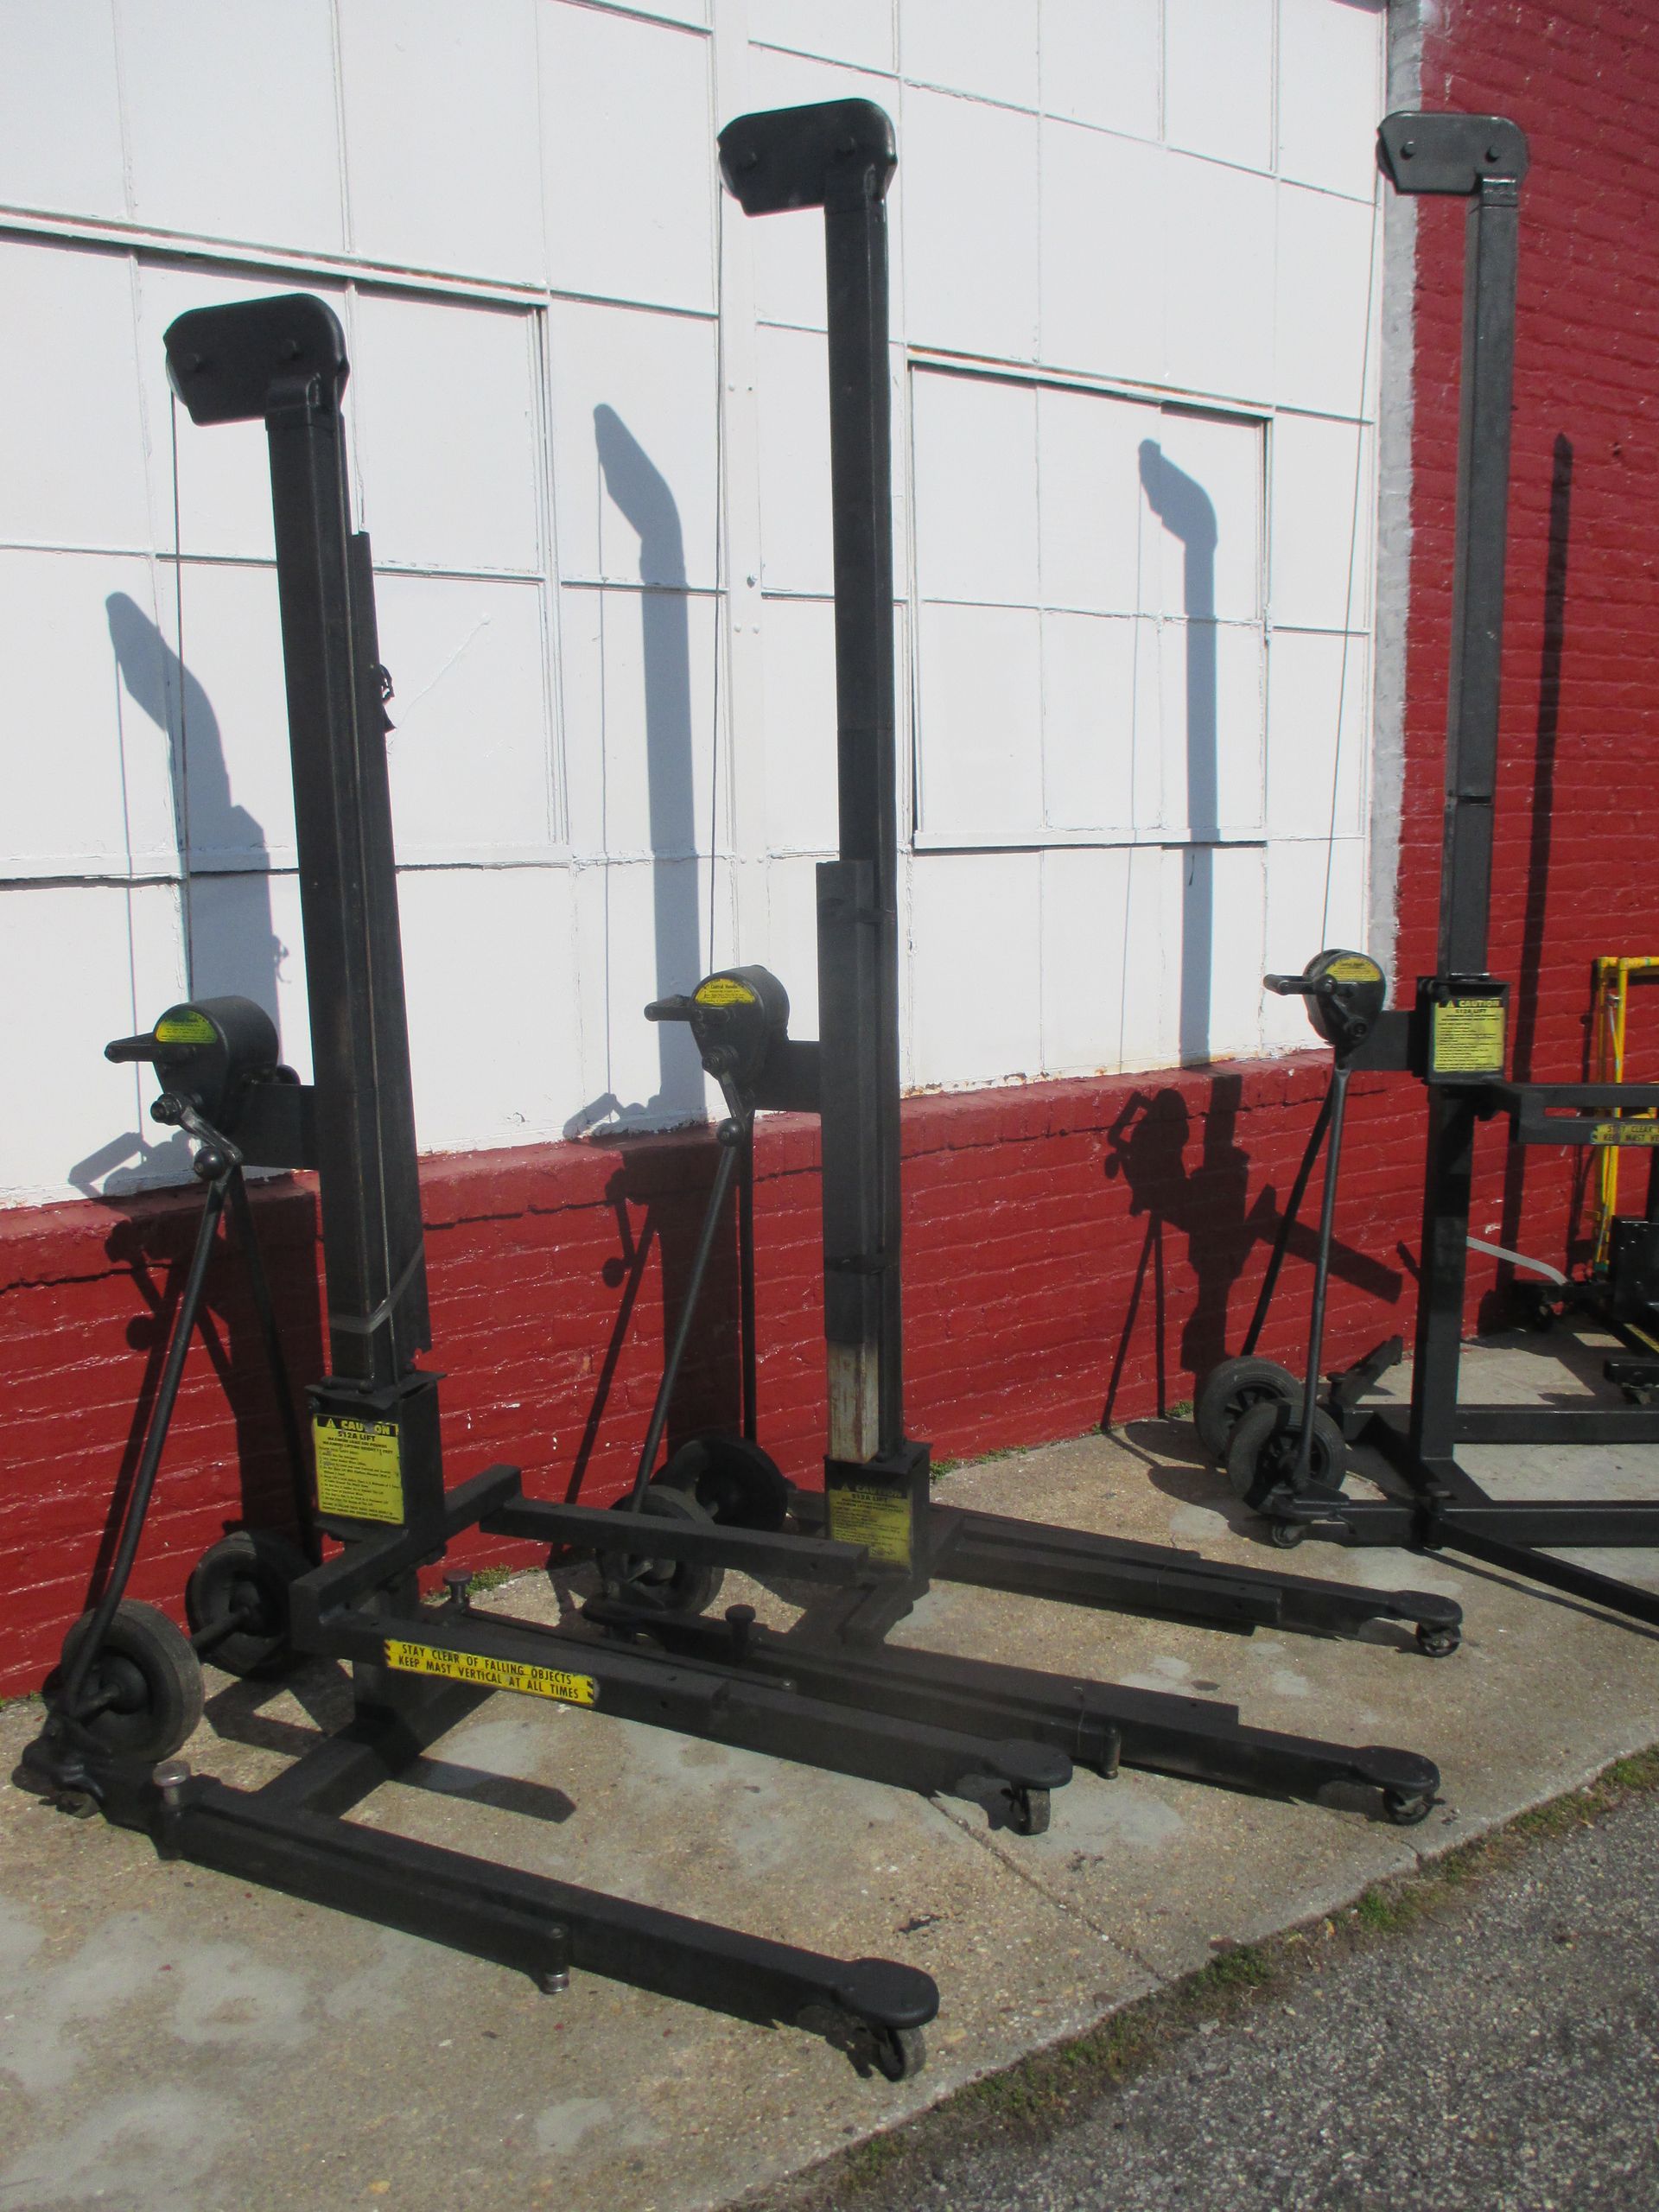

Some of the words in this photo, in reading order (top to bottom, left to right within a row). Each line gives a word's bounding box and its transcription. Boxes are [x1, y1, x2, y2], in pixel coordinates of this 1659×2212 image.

[338, 1431, 358, 1440] 512A
[340, 1420, 391, 1436] CAUON
[398, 1656, 420, 1668] KEEP
[425, 1661, 453, 1675] MAST
[458, 1667, 502, 1685] VERTICAL
[508, 1676, 521, 1688] AT
[527, 1680, 544, 1693] ALL
[550, 1683, 580, 1699] TIMES
[402, 1643, 425, 1657] STAY
[431, 1649, 460, 1664] CLEAR
[467, 1656, 480, 1667] OF
[484, 1659, 524, 1676] FALLING
[531, 1669, 572, 1685] OBJECTS
